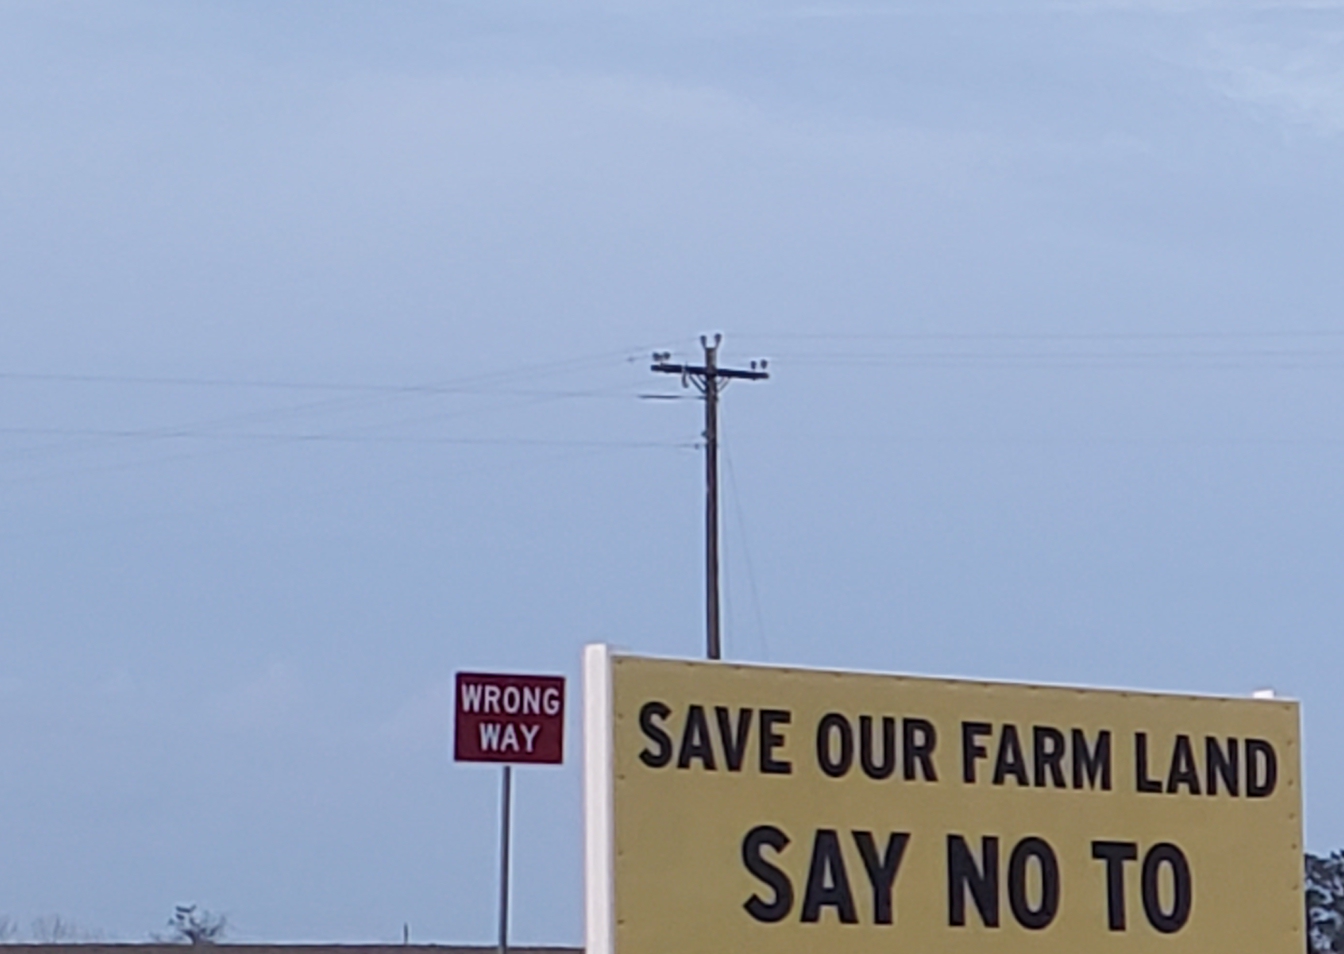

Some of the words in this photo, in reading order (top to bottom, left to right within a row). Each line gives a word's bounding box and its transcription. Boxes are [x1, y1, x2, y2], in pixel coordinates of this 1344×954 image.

[462, 684, 559, 714] WRONG
[480, 723, 539, 752] WAY
[639, 702, 792, 774] SAVE
[816, 713, 938, 782] OUR
[961, 721, 1111, 791] FARM
[1135, 732, 1277, 797] LAND
[742, 825, 910, 925] SAY
[947, 834, 1059, 930] NO
[1091, 841, 1191, 934] TO
